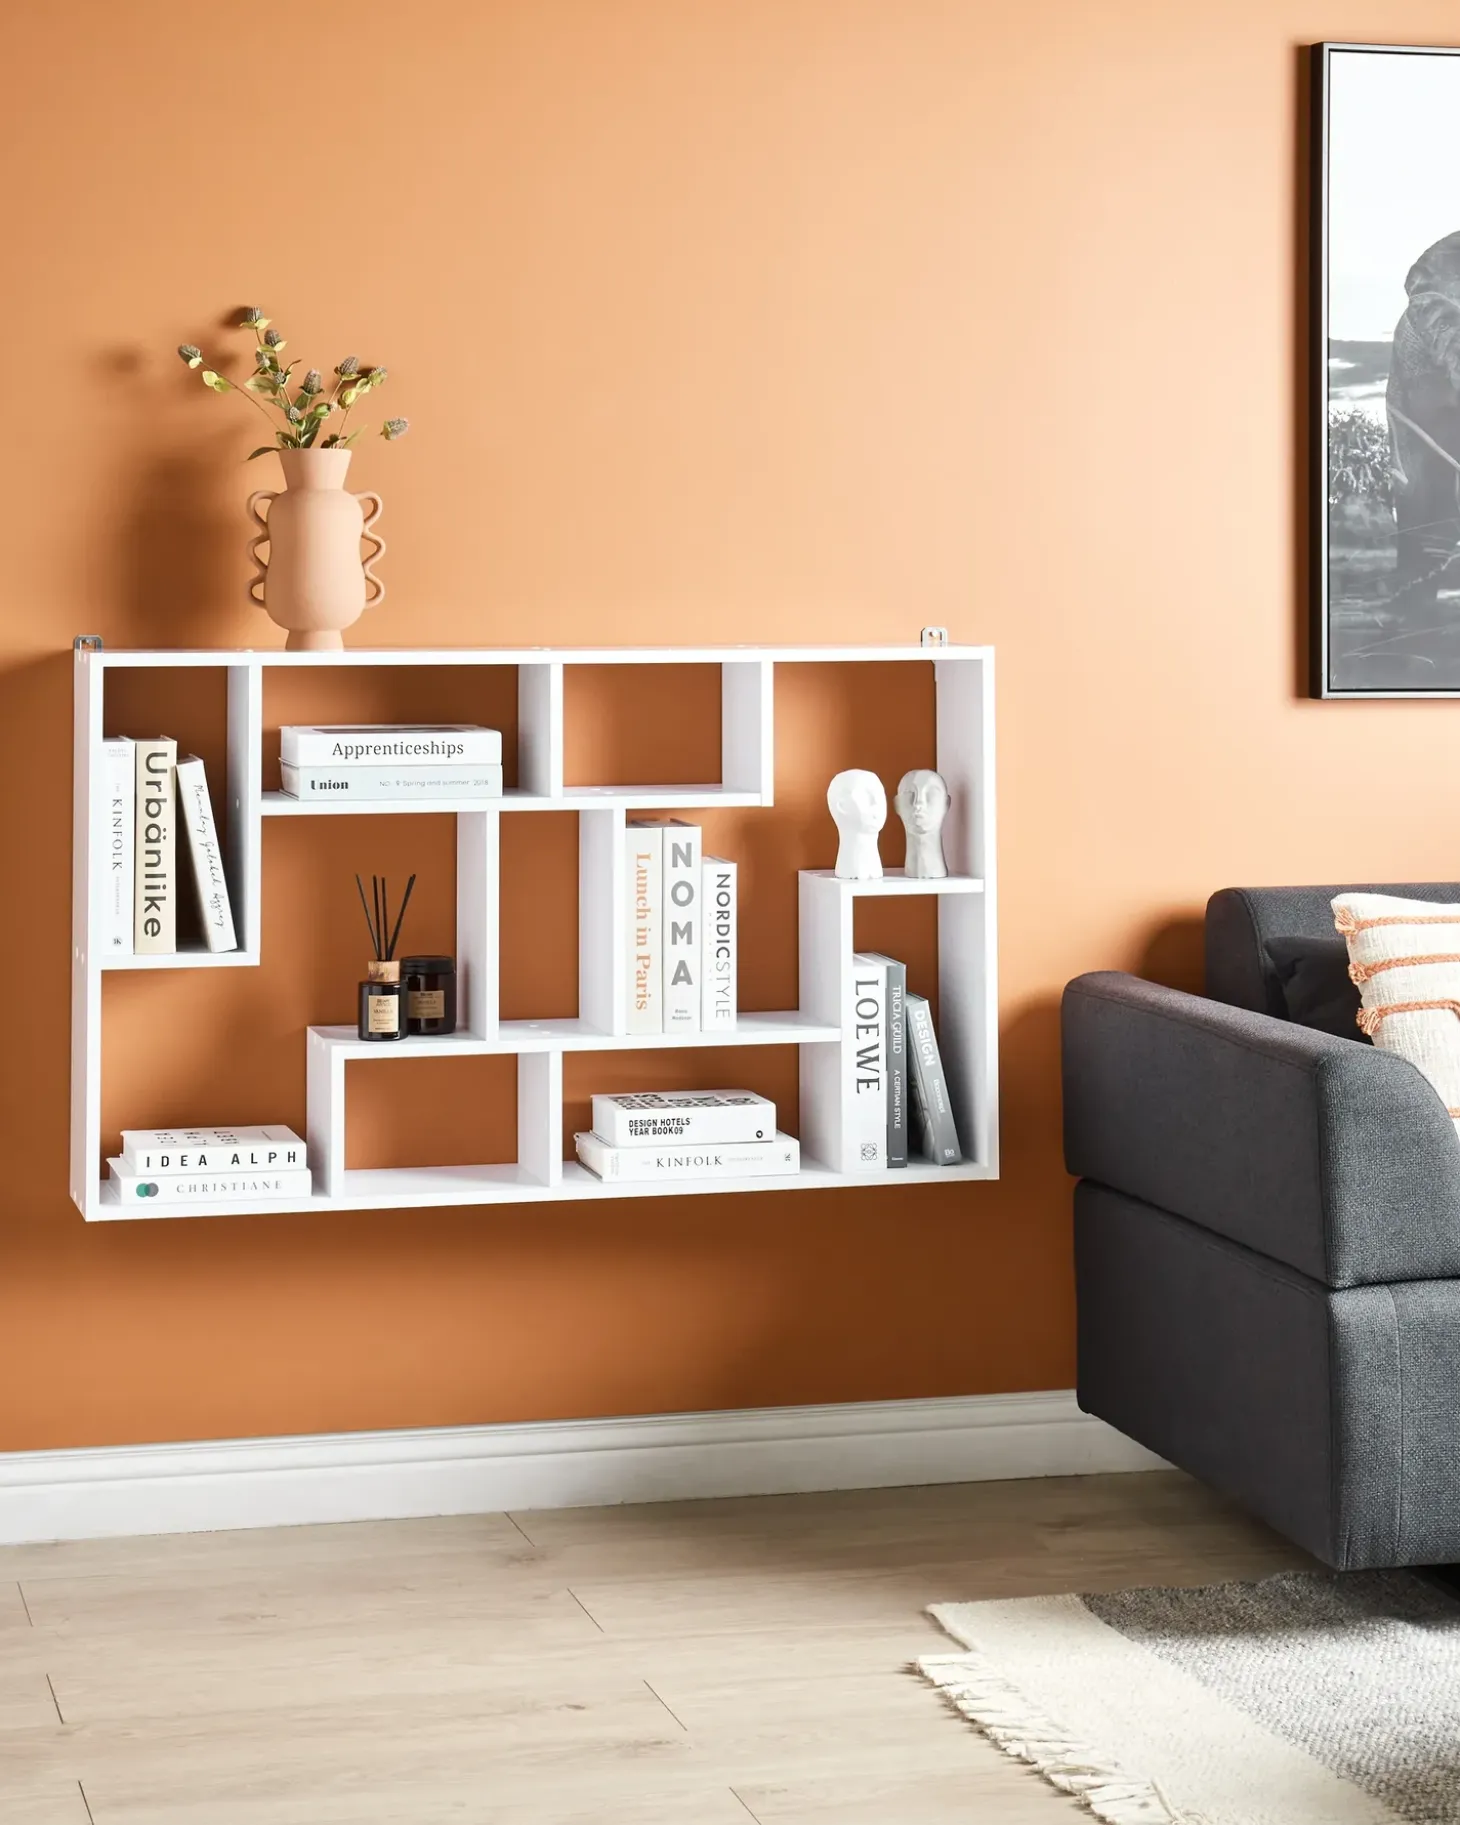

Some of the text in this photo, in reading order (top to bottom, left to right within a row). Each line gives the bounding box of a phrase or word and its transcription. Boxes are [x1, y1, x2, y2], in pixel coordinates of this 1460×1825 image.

[332, 740, 464, 760] Apprenticeships
[310, 779, 349, 791] Union
[402, 779, 426, 789] Spring
[427, 779, 441, 788] and
[442, 779, 471, 788] summer
[473, 778, 490, 788] 2018
[112, 798, 124, 871] KINFOLK
[143, 751, 168, 938] Urbänlike
[670, 842, 695, 986] NOMA
[635, 853, 652, 1011] Lunch in Paris
[892, 985, 902, 1019] TRICIA
[855, 979, 881, 1095] LOEWE
[892, 1021, 902, 1054] GUILD
[914, 1009, 936, 1067] DESIGN
[628, 1117, 691, 1130] DESIGN HOTELS
[893, 1107, 902, 1129] STYLE
[628, 1127, 650, 1136] YEAR
[146, 1151, 296, 1168] IDEA ALPH
[656, 1155, 723, 1168] KINFOLK
[176, 1180, 283, 1194] CHRISTIANE
